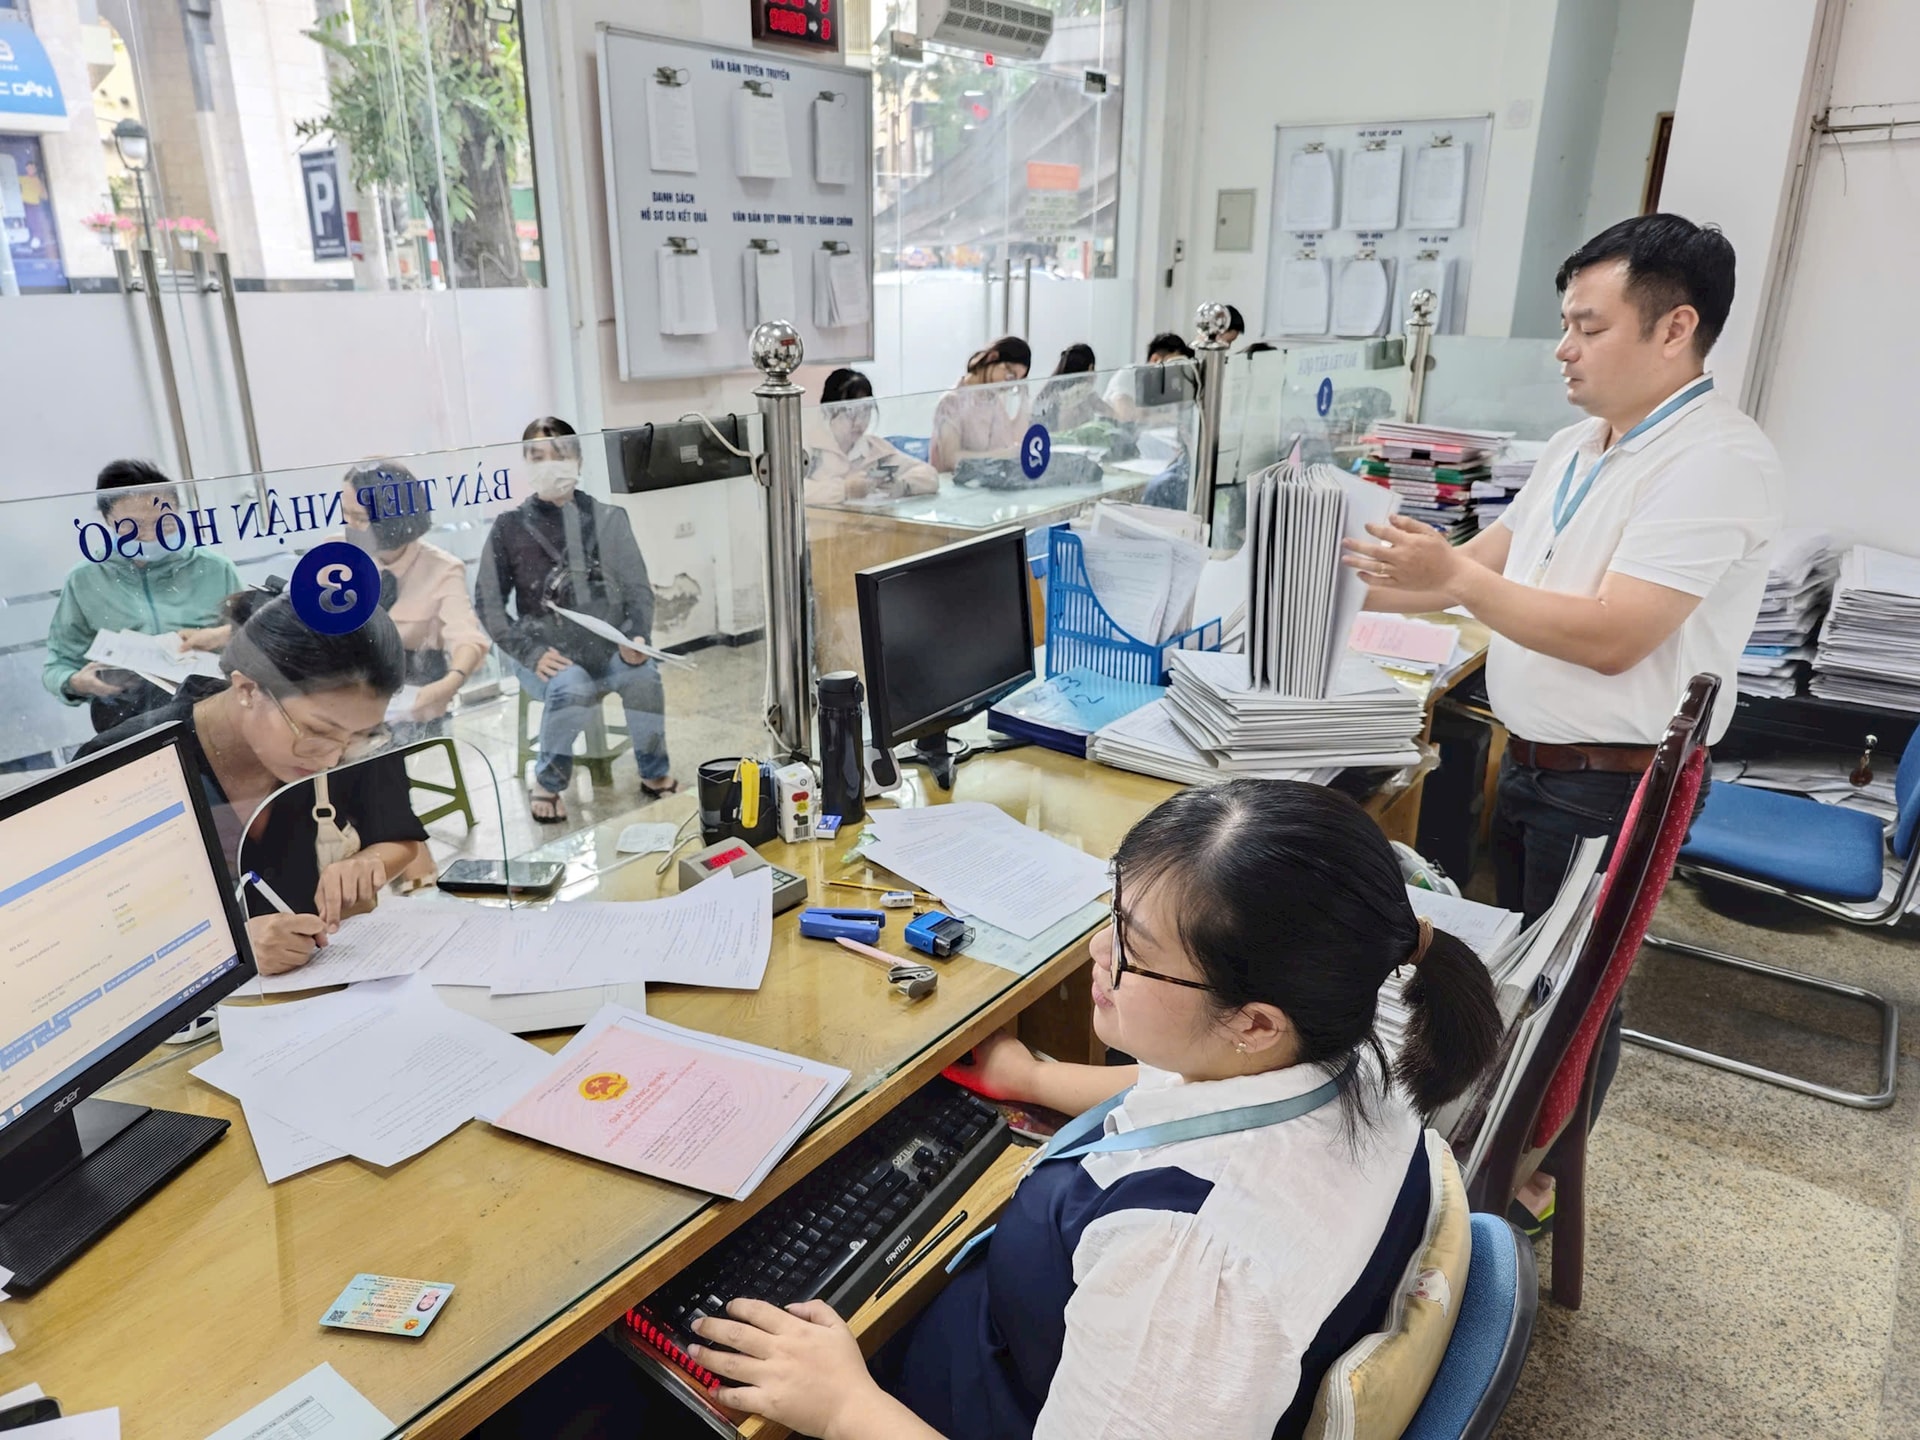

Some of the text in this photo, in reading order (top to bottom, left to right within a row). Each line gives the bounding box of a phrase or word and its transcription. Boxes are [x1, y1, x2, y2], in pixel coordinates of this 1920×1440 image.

[308, 170, 336, 236] P
[53, 1086, 81, 1113] acer
[885, 1235, 912, 1265] FANTECH
